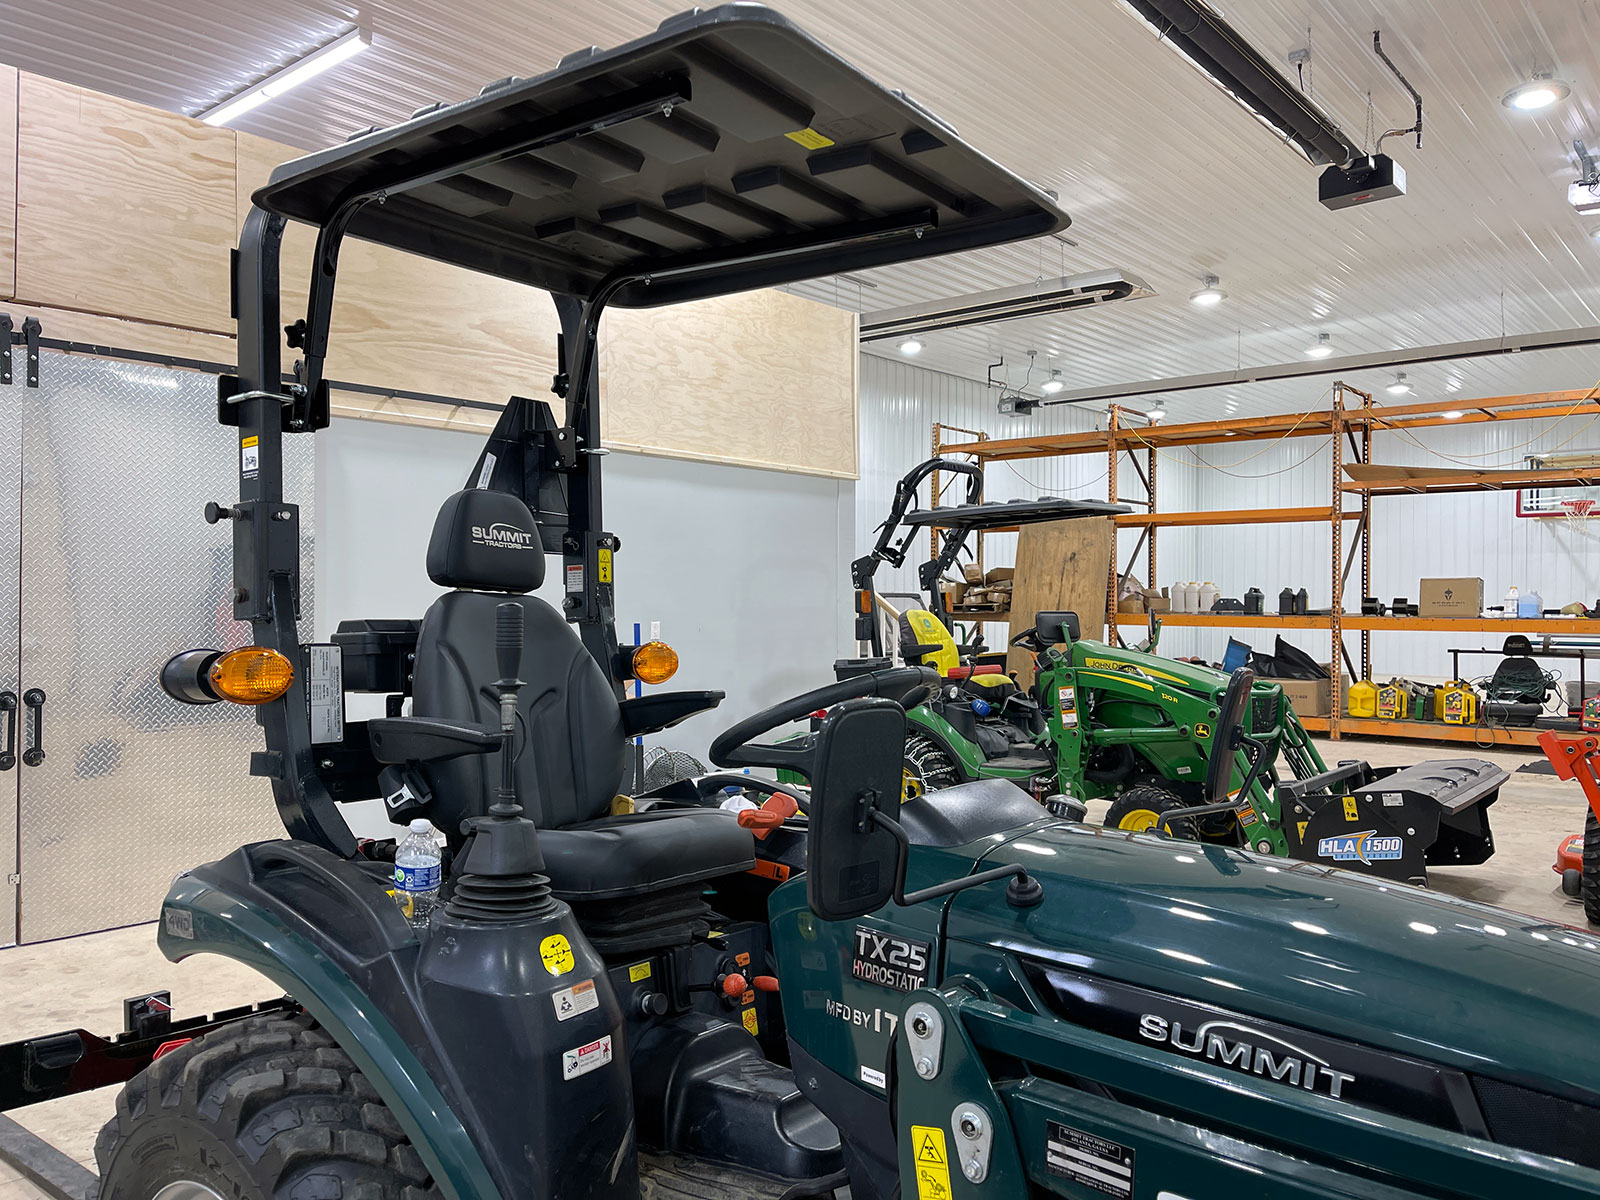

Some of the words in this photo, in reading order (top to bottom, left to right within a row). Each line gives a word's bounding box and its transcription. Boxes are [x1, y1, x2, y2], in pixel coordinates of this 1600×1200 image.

[472, 523, 531, 544] SUMMIT
[484, 540, 522, 550] TRACTORS
[1091, 660, 1110, 670] JOHN
[1320, 840, 1356, 853] HLA
[1366, 839, 1400, 852] 1500
[776, 866, 783, 878] L
[856, 930, 926, 972] TX25
[852, 958, 924, 990] HYDROSTATIC
[826, 999, 850, 1022] MFD
[853, 1008, 872, 1029] BY
[1139, 1014, 1356, 1098] SUMMIT
